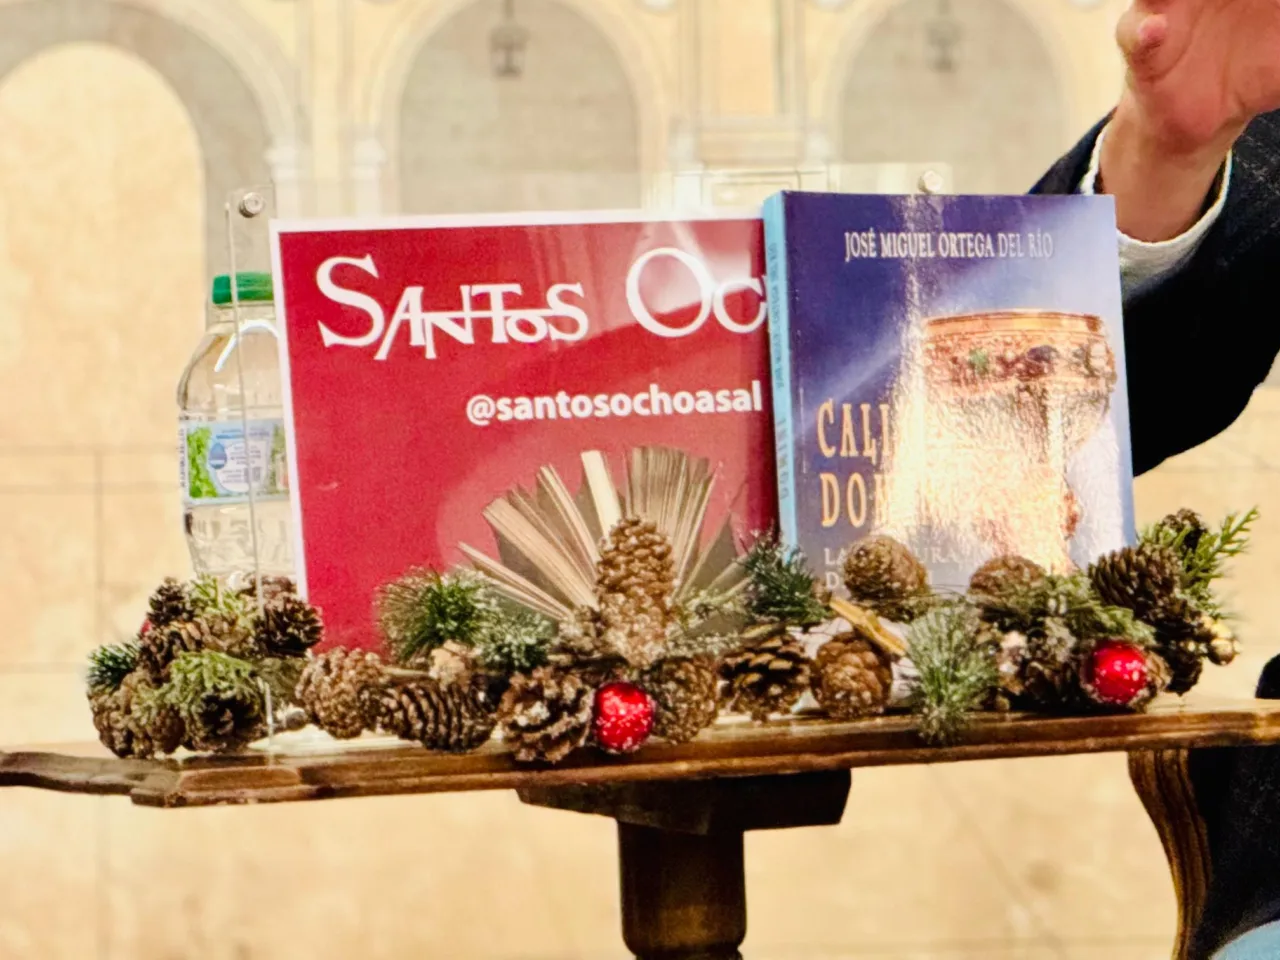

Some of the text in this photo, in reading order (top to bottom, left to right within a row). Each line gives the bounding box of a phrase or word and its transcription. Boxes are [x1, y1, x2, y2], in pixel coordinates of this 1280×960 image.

[844, 226, 1054, 262] JOSÉ MIGUEL ORTEGA DEL RÍO
[626, 246, 769, 339] OC
[466, 380, 764, 427] @santosochoasal
[816, 398, 892, 467] CALI
